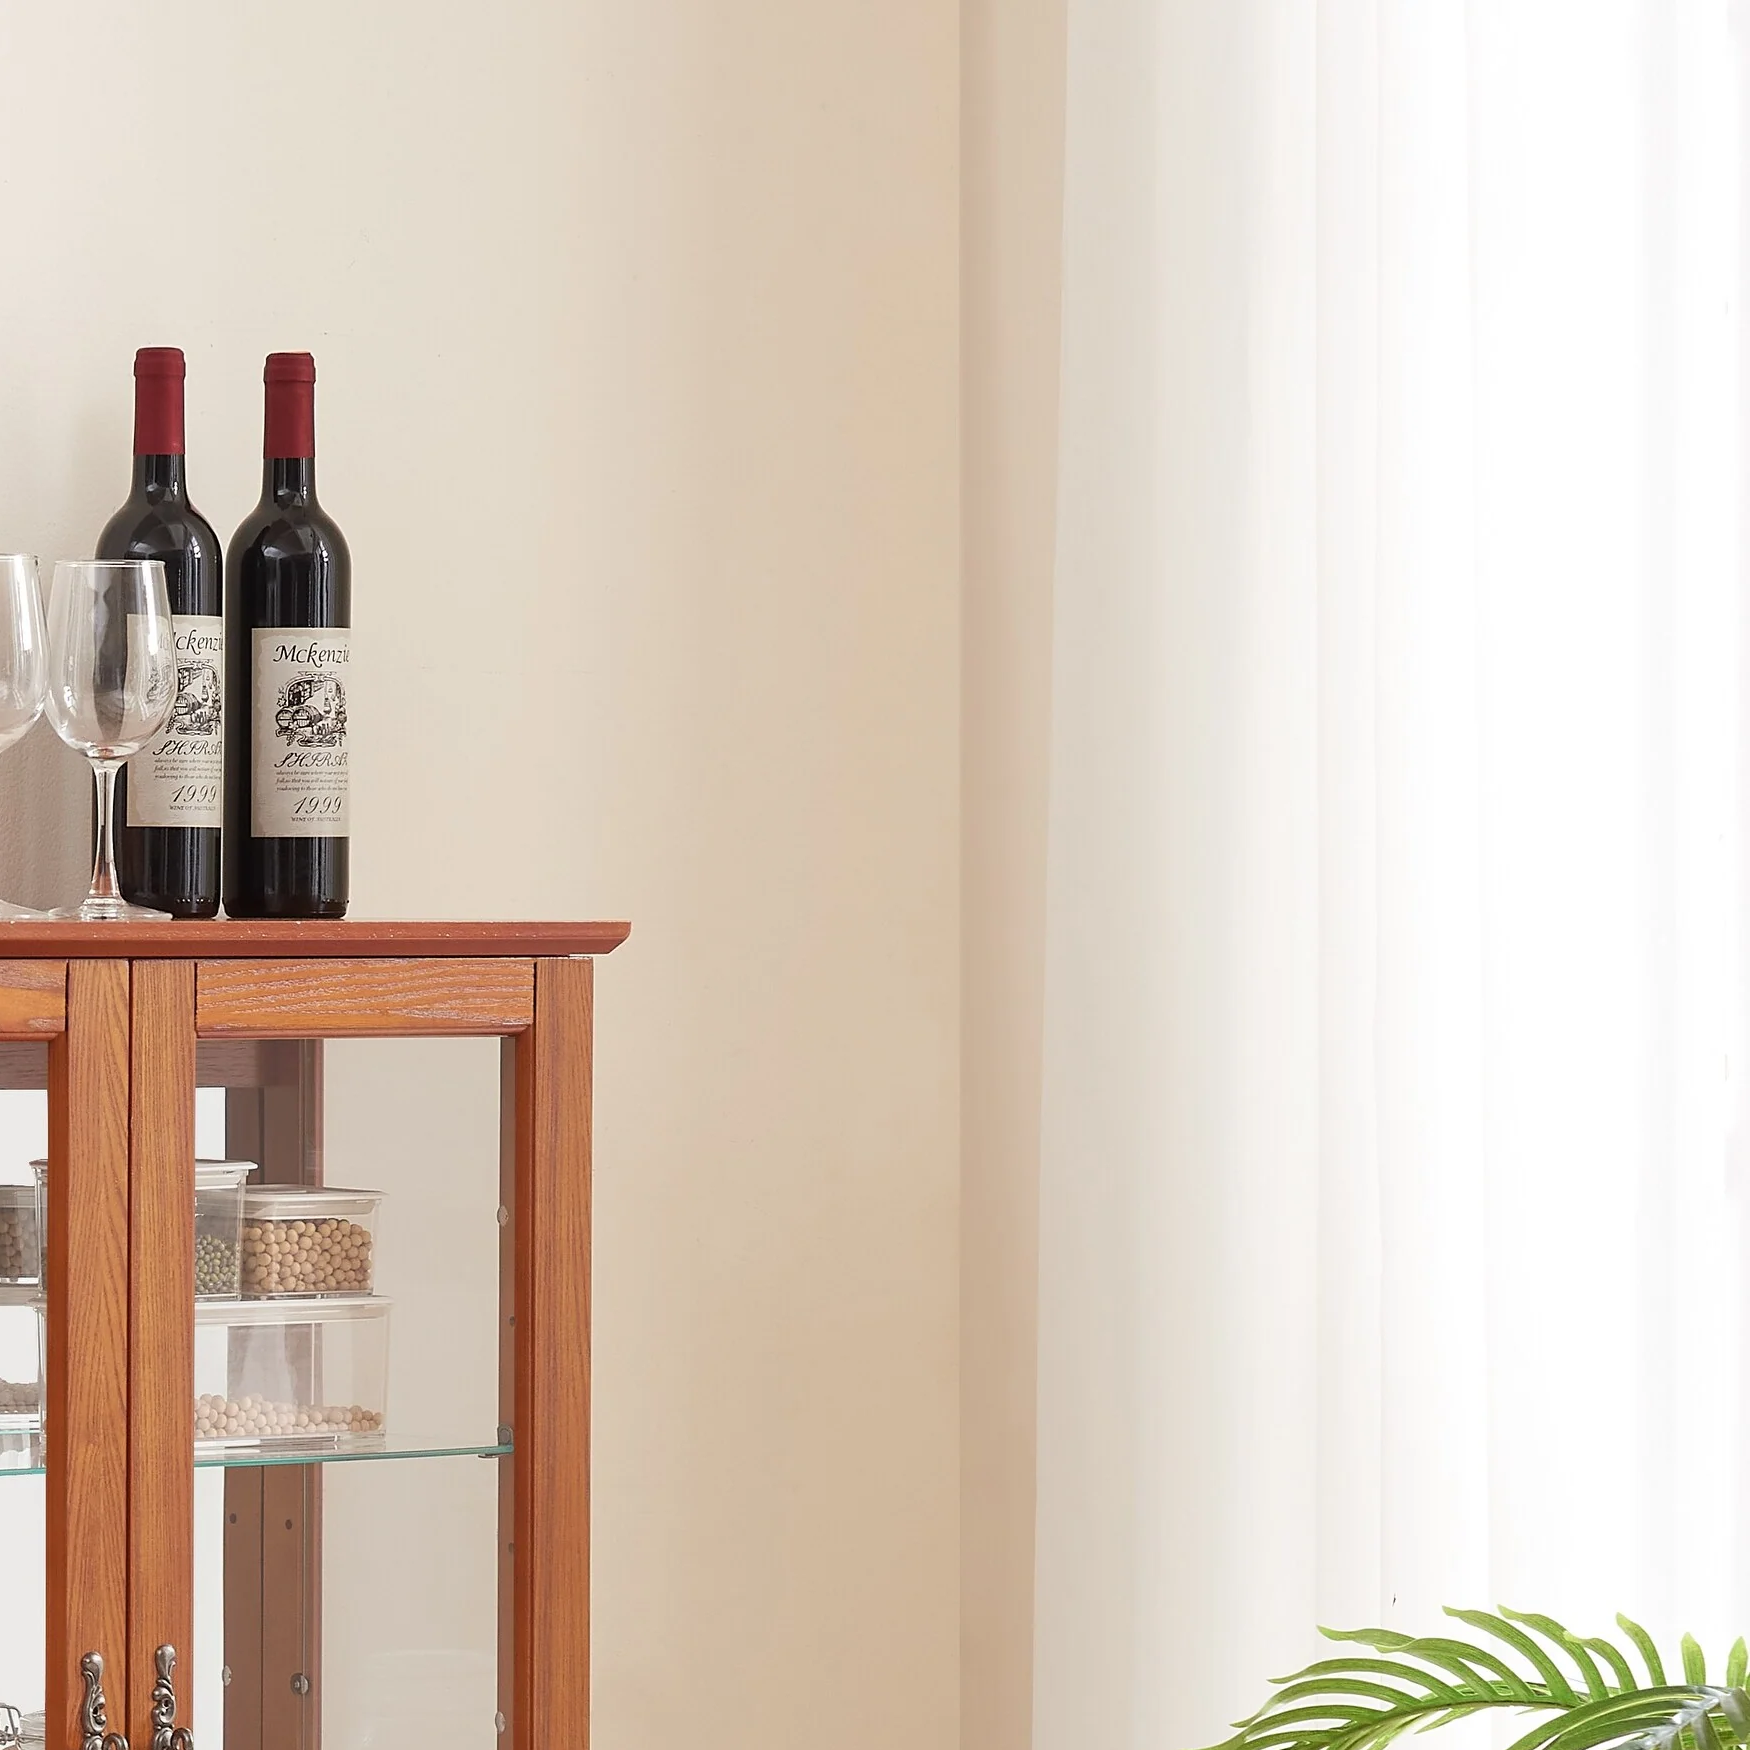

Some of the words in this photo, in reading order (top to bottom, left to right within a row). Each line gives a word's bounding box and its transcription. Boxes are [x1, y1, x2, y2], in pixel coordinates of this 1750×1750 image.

[173, 629, 223, 655] ckenzi
[172, 785, 217, 803] 1999
[293, 796, 342, 814] 1999
